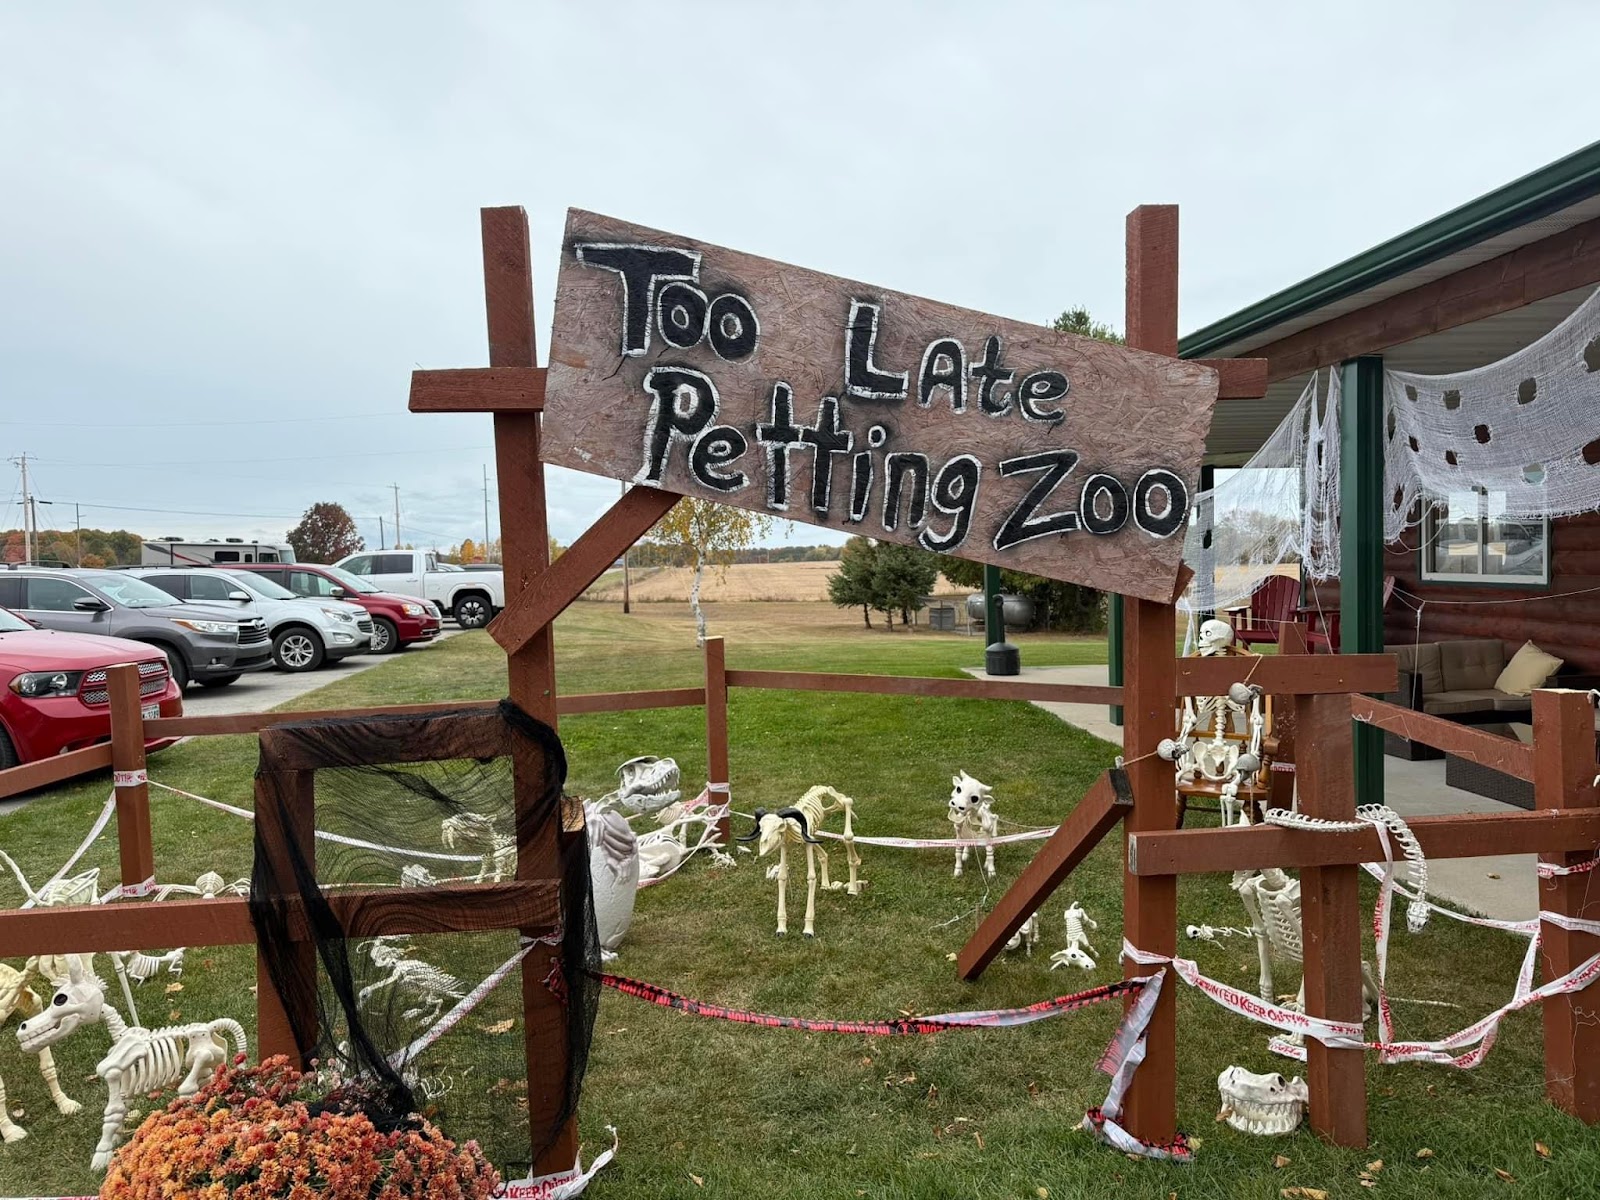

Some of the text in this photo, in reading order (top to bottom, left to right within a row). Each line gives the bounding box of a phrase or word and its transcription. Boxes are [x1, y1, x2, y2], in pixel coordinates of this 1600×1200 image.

[575, 242, 761, 365] Too
[633, 365, 1190, 553] Petting Zoo
